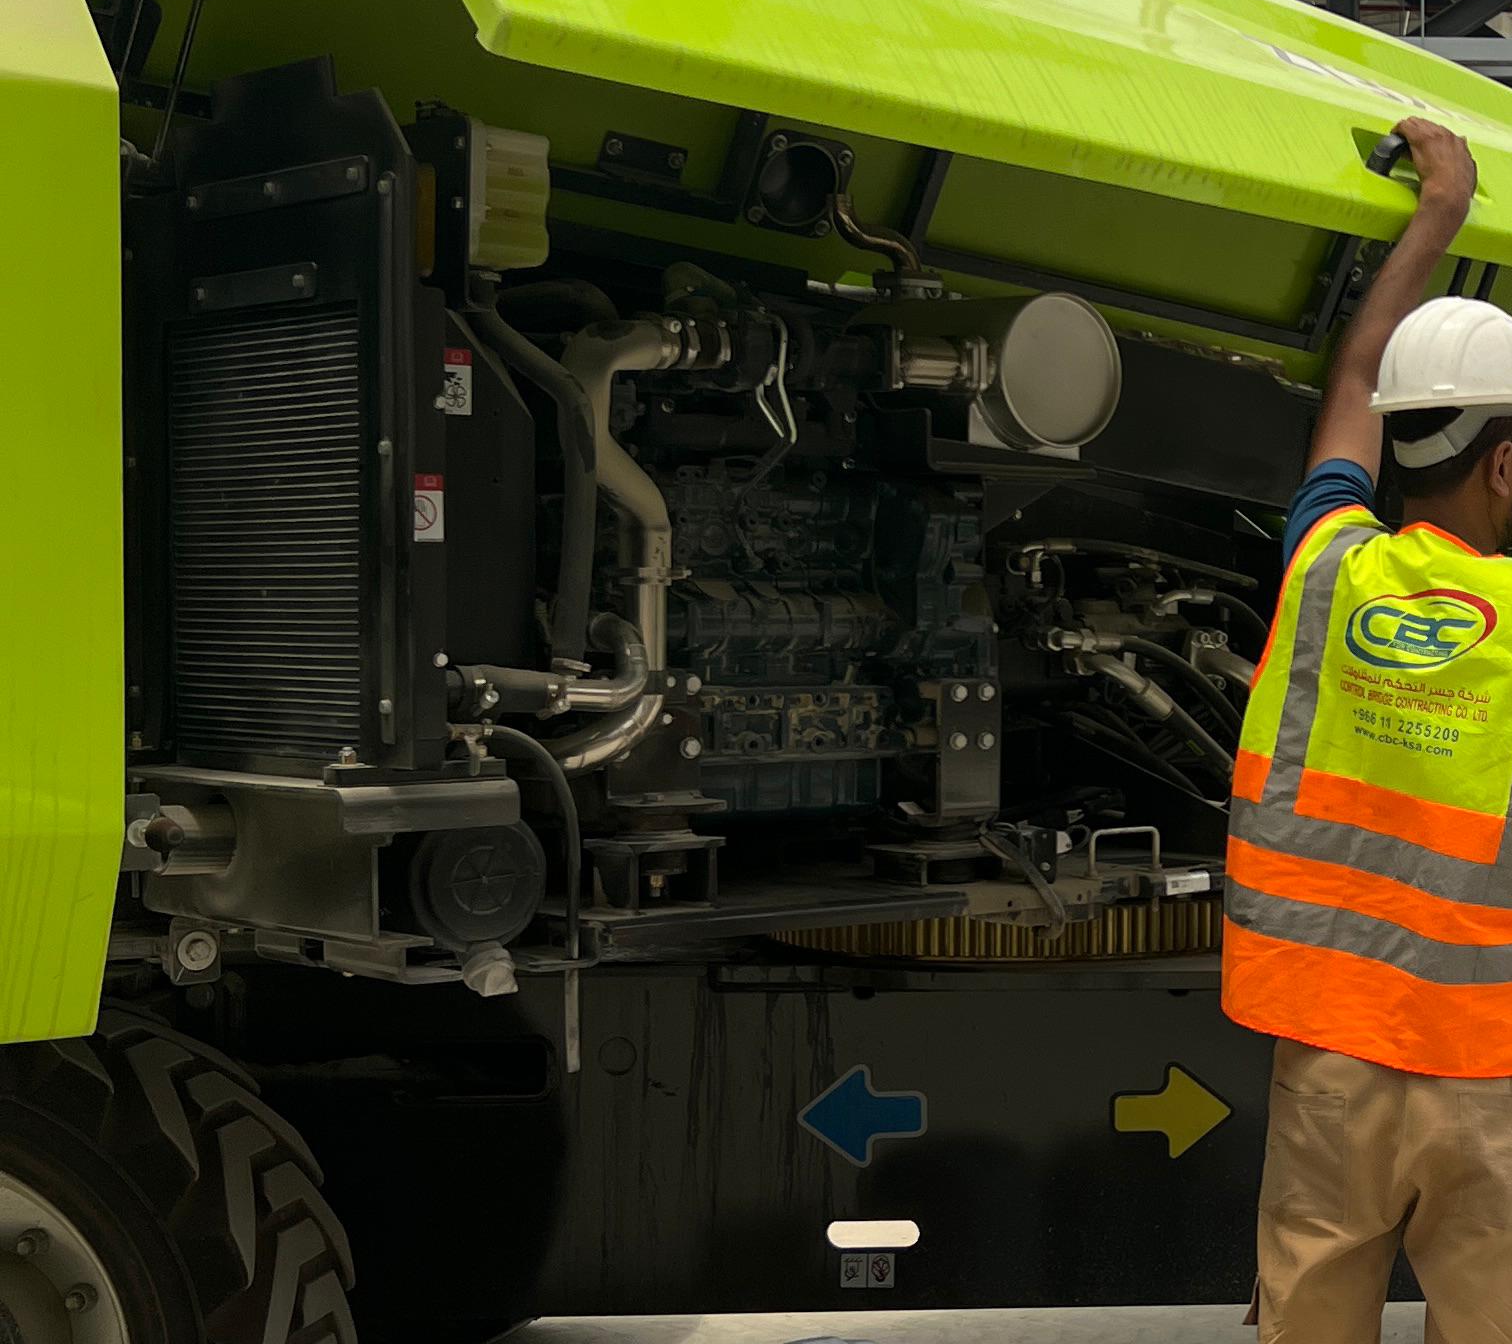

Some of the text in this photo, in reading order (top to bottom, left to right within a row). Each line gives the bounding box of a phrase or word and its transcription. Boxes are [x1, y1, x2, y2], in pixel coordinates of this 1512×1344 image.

[1361, 606, 1478, 649] CBC
[1395, 695, 1453, 717] CONTRACTING
[1458, 687, 1492, 704] شركة
[1354, 725, 1453, 757] www.cbc-ksa.com
